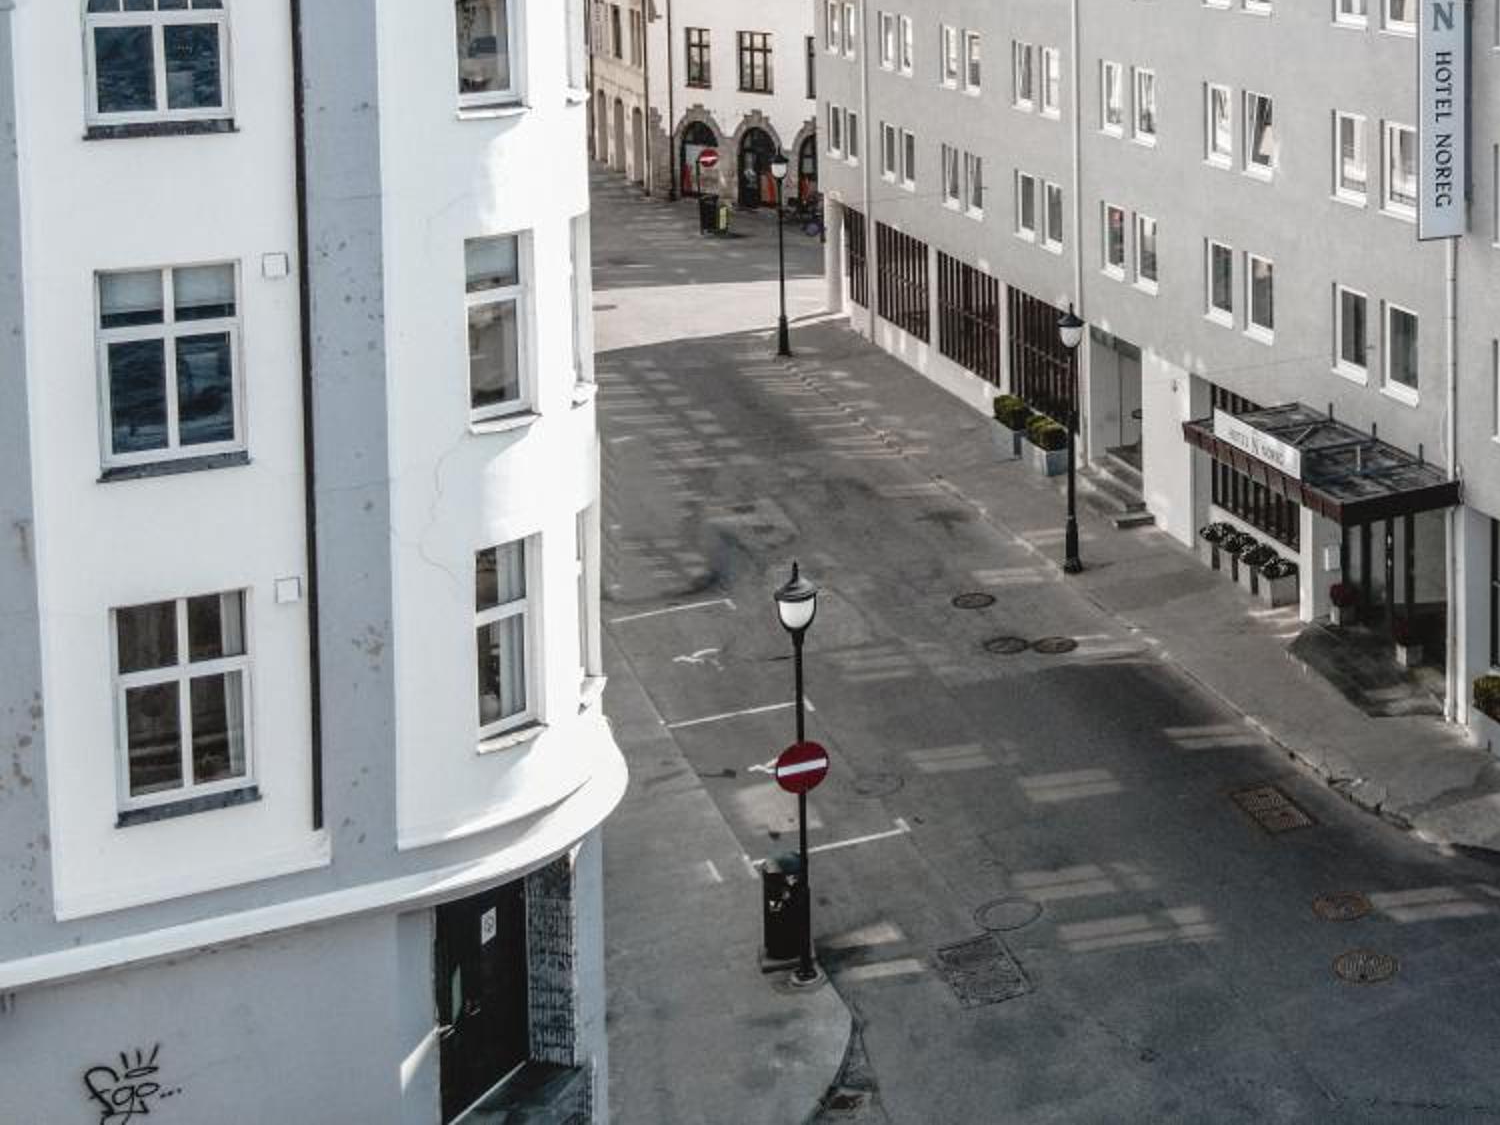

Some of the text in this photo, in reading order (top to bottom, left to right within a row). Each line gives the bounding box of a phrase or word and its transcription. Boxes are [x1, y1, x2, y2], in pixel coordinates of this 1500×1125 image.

[1431, 1, 1455, 31] N
[1435, 51, 1453, 208] HOTEL NOREG
